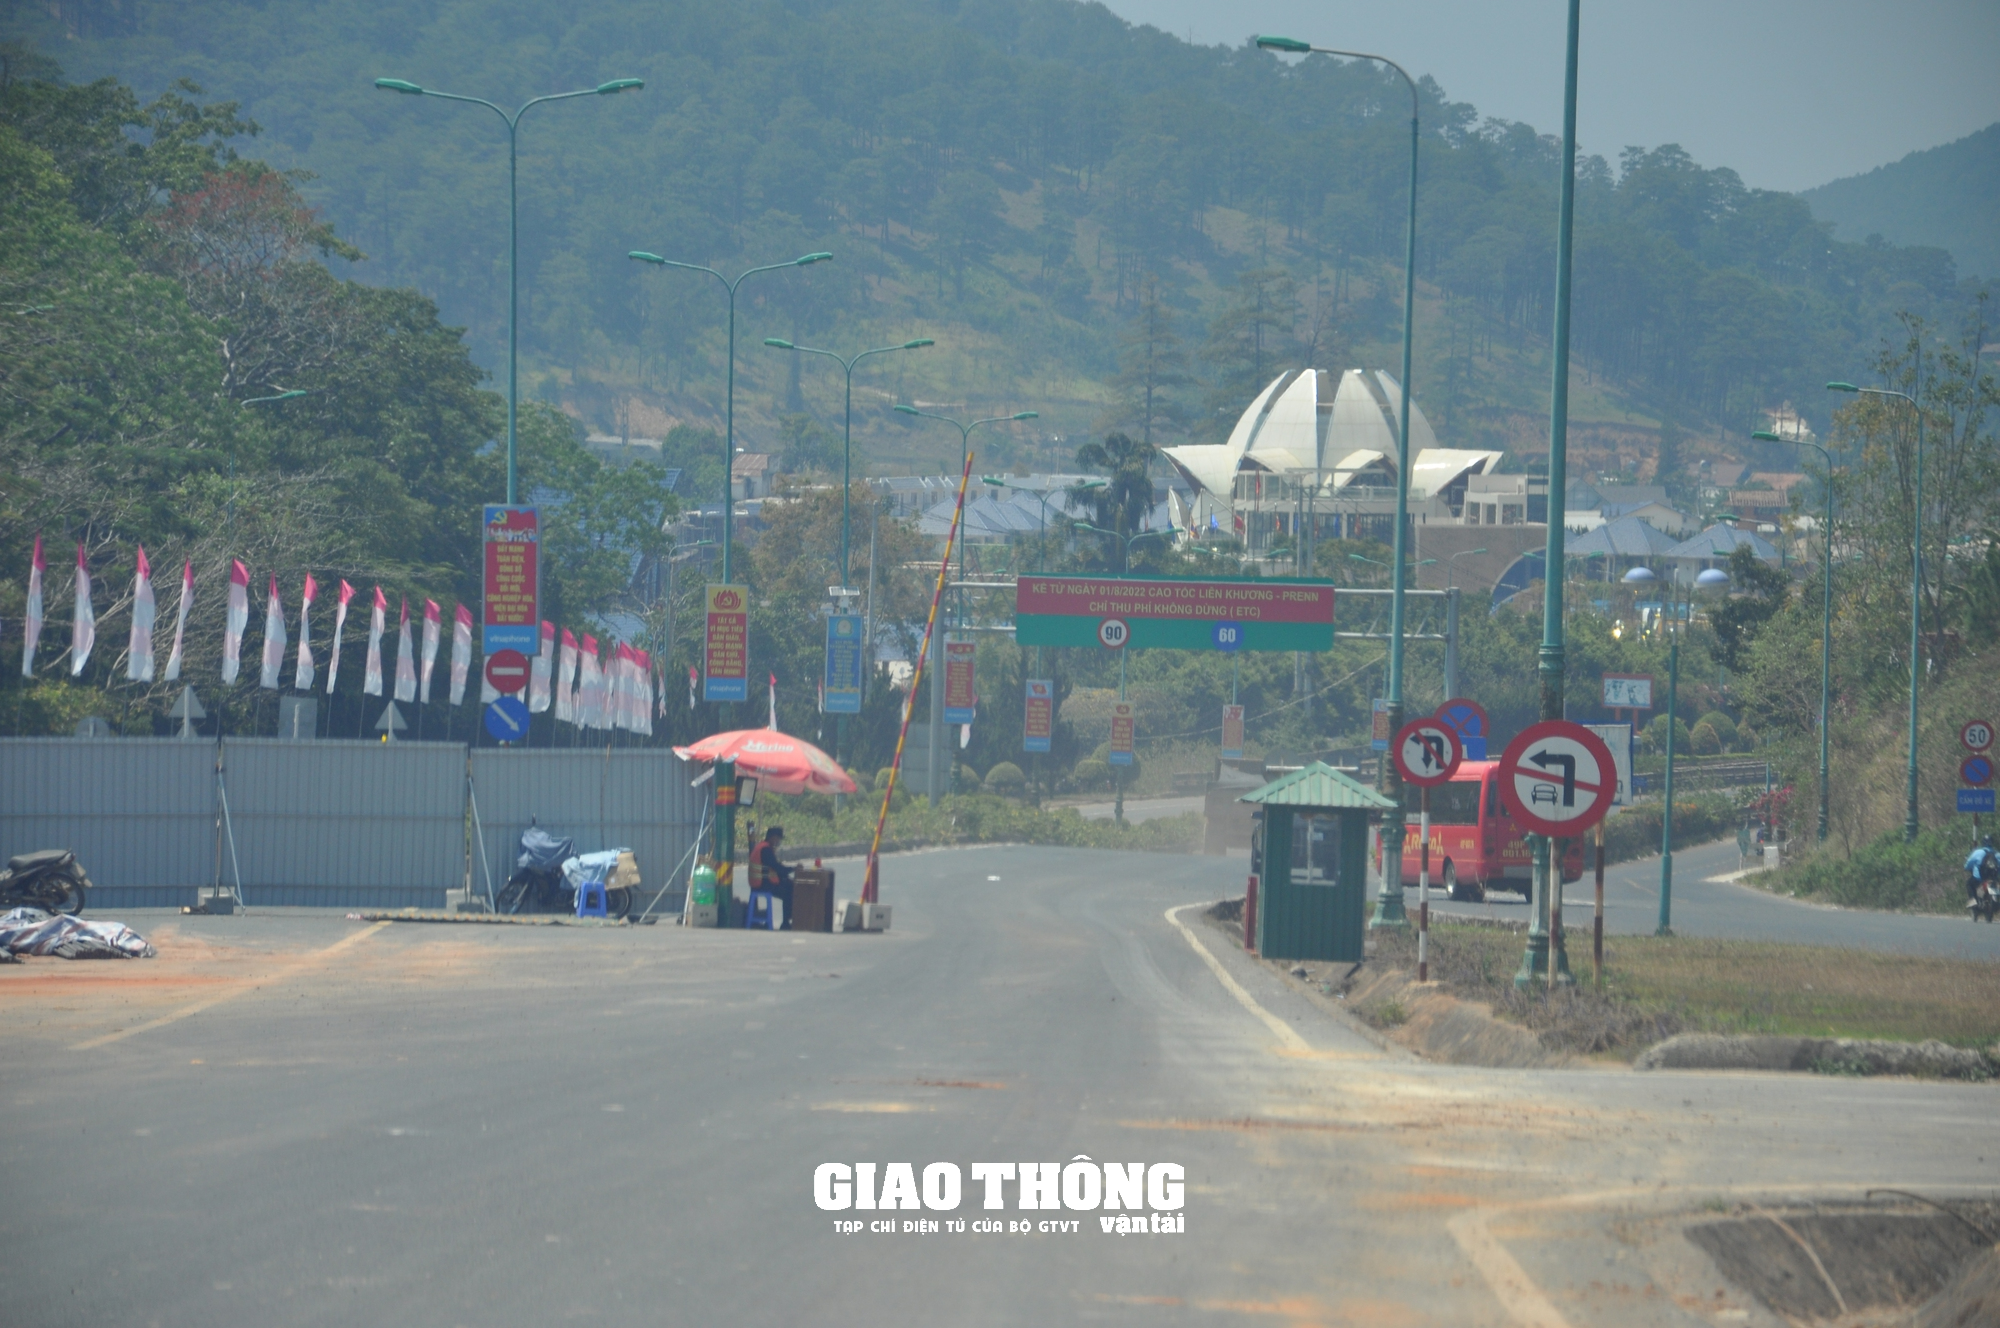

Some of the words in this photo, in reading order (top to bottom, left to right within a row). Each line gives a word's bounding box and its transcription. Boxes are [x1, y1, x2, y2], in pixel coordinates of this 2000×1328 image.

[1050, 582, 1065, 595] TỪ
[1067, 583, 1097, 595] NGÀY
[1100, 585, 1146, 597] 01/8/2022
[1149, 587, 1172, 598] CAO
[1199, 586, 1222, 599] LIÊN
[1225, 588, 1273, 600] KHƯƠNG
[1283, 591, 1319, 602] PRENN
[1110, 602, 1131, 613] THU
[1134, 602, 1152, 613] PHÍ
[1154, 602, 1193, 615] KHÔNG
[1195, 603, 1227, 616] DỪNG
[489, 632, 531, 644] vinaphone
[1105, 626, 1122, 640] 90
[1218, 627, 1236, 643] 60
[1968, 728, 1986, 744] 50
